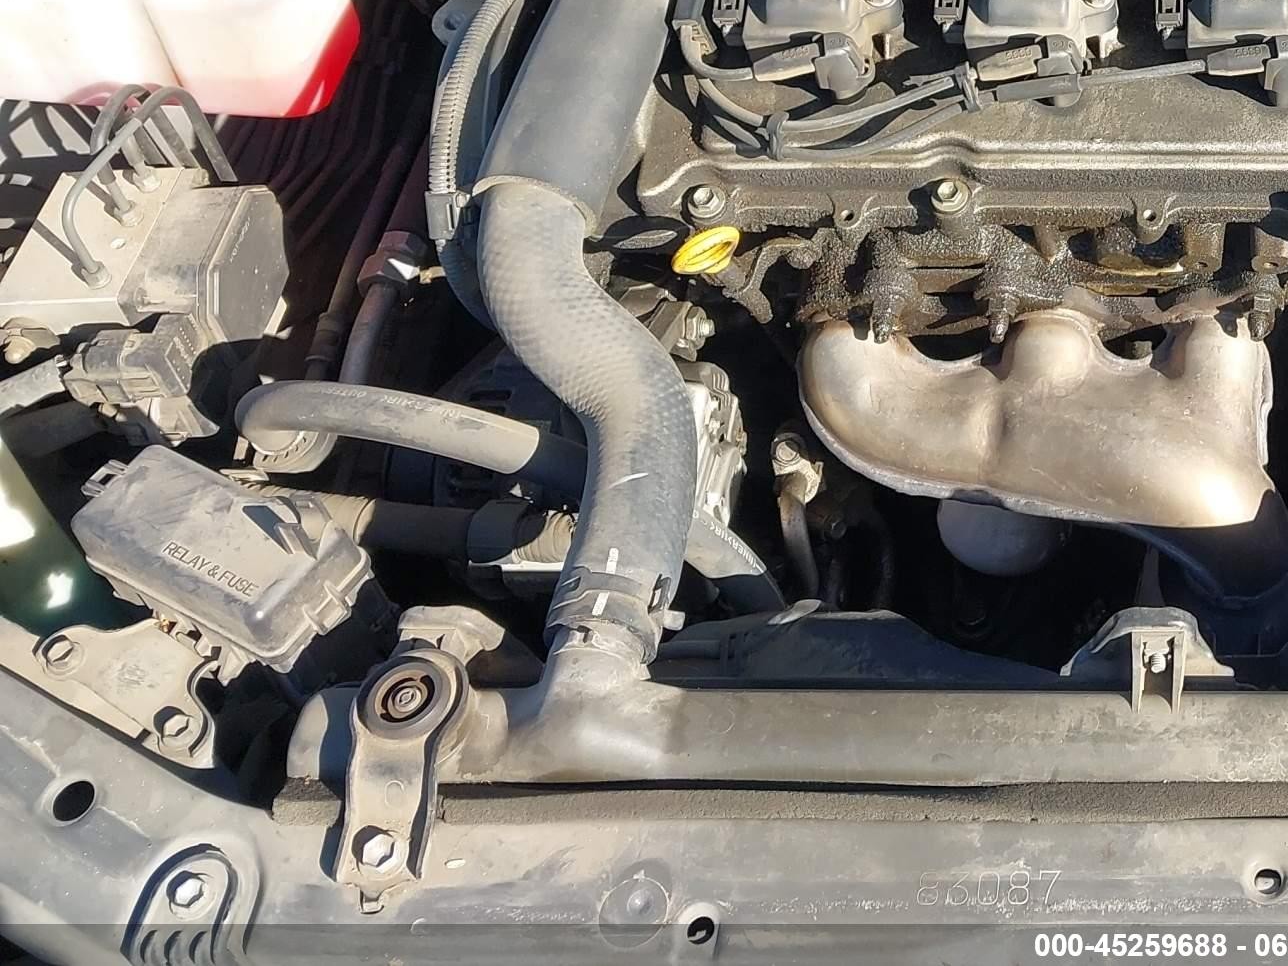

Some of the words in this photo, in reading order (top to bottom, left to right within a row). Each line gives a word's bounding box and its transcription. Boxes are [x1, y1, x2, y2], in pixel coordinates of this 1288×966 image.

[162, 541, 212, 571] RELAY
[207, 564, 220, 579] &
[217, 570, 260, 597] FUSE
[916, 870, 1063, 906] 83087
